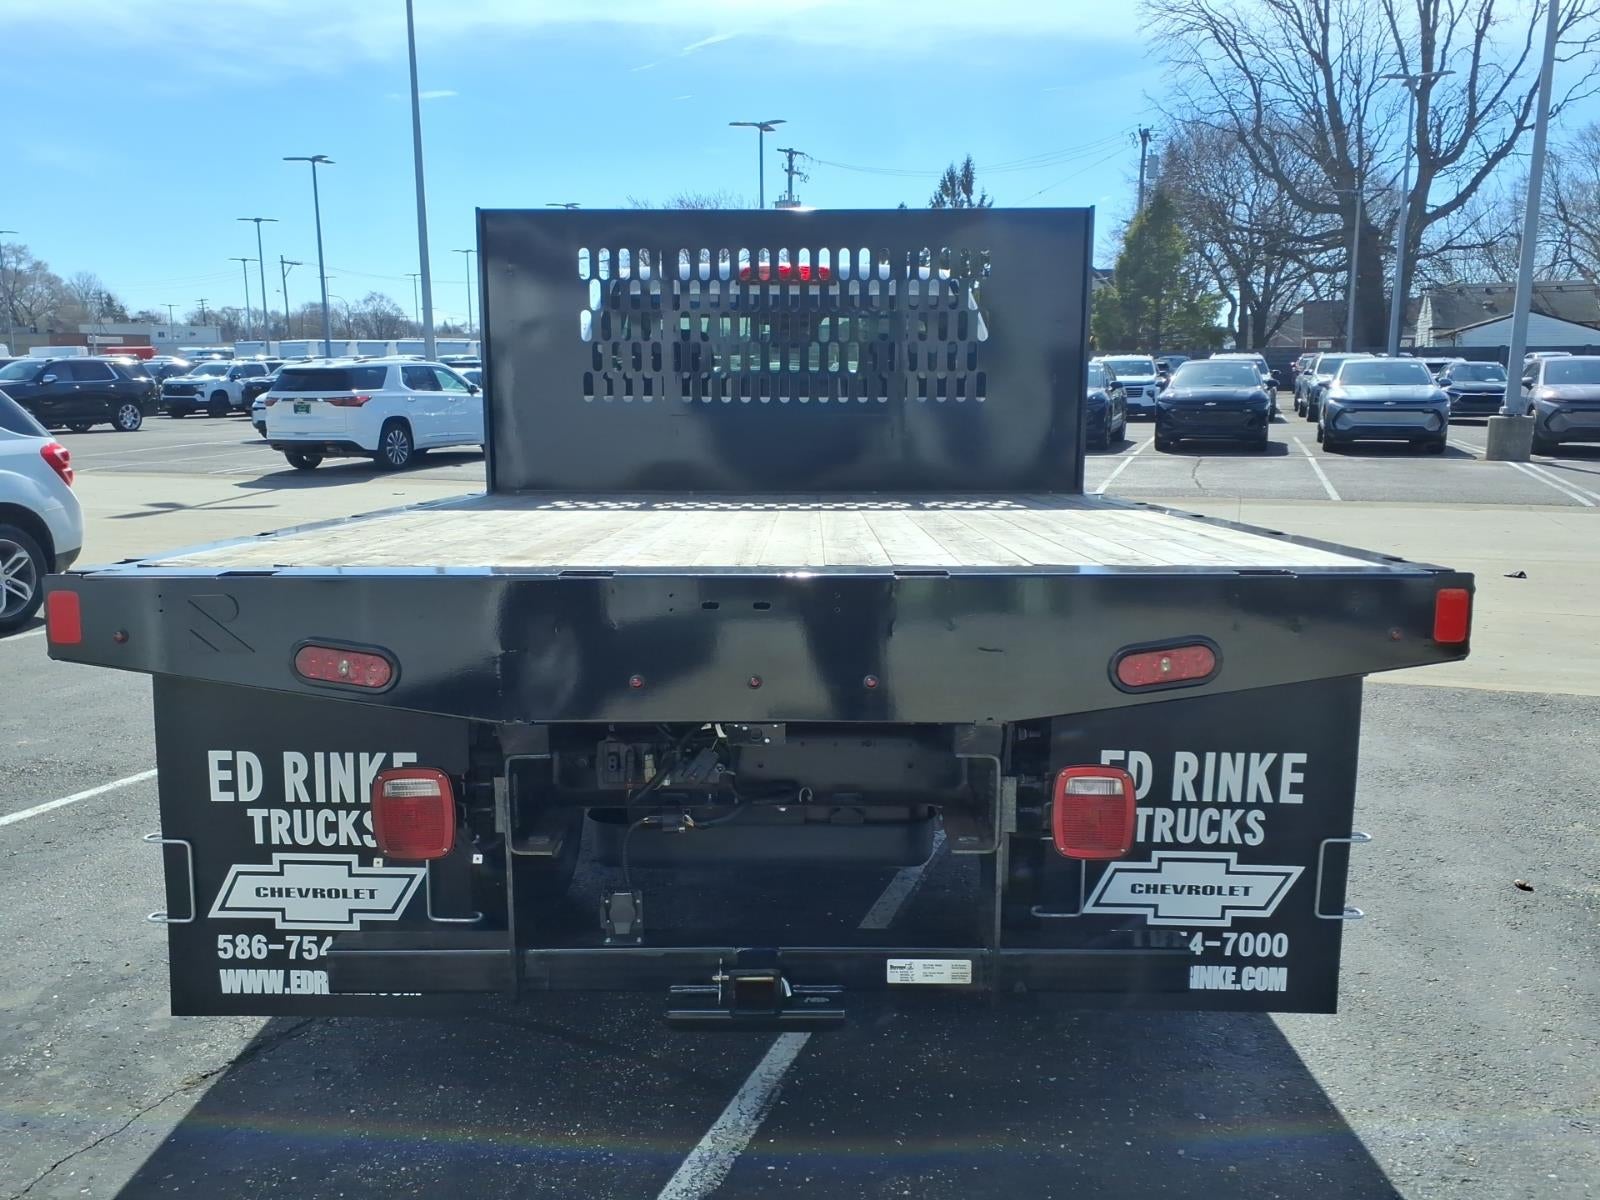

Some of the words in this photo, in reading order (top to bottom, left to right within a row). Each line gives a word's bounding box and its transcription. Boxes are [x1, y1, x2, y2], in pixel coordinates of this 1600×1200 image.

[208, 750, 263, 802] ED
[1171, 751, 1308, 804] RINKE
[1135, 807, 1266, 846] TRUCKS
[254, 886, 379, 900] CHEVROLET
[1130, 882, 1254, 897] CHEVROLET
[217, 934, 333, 960] 586-754
[1180, 931, 1289, 958] 4-7000
